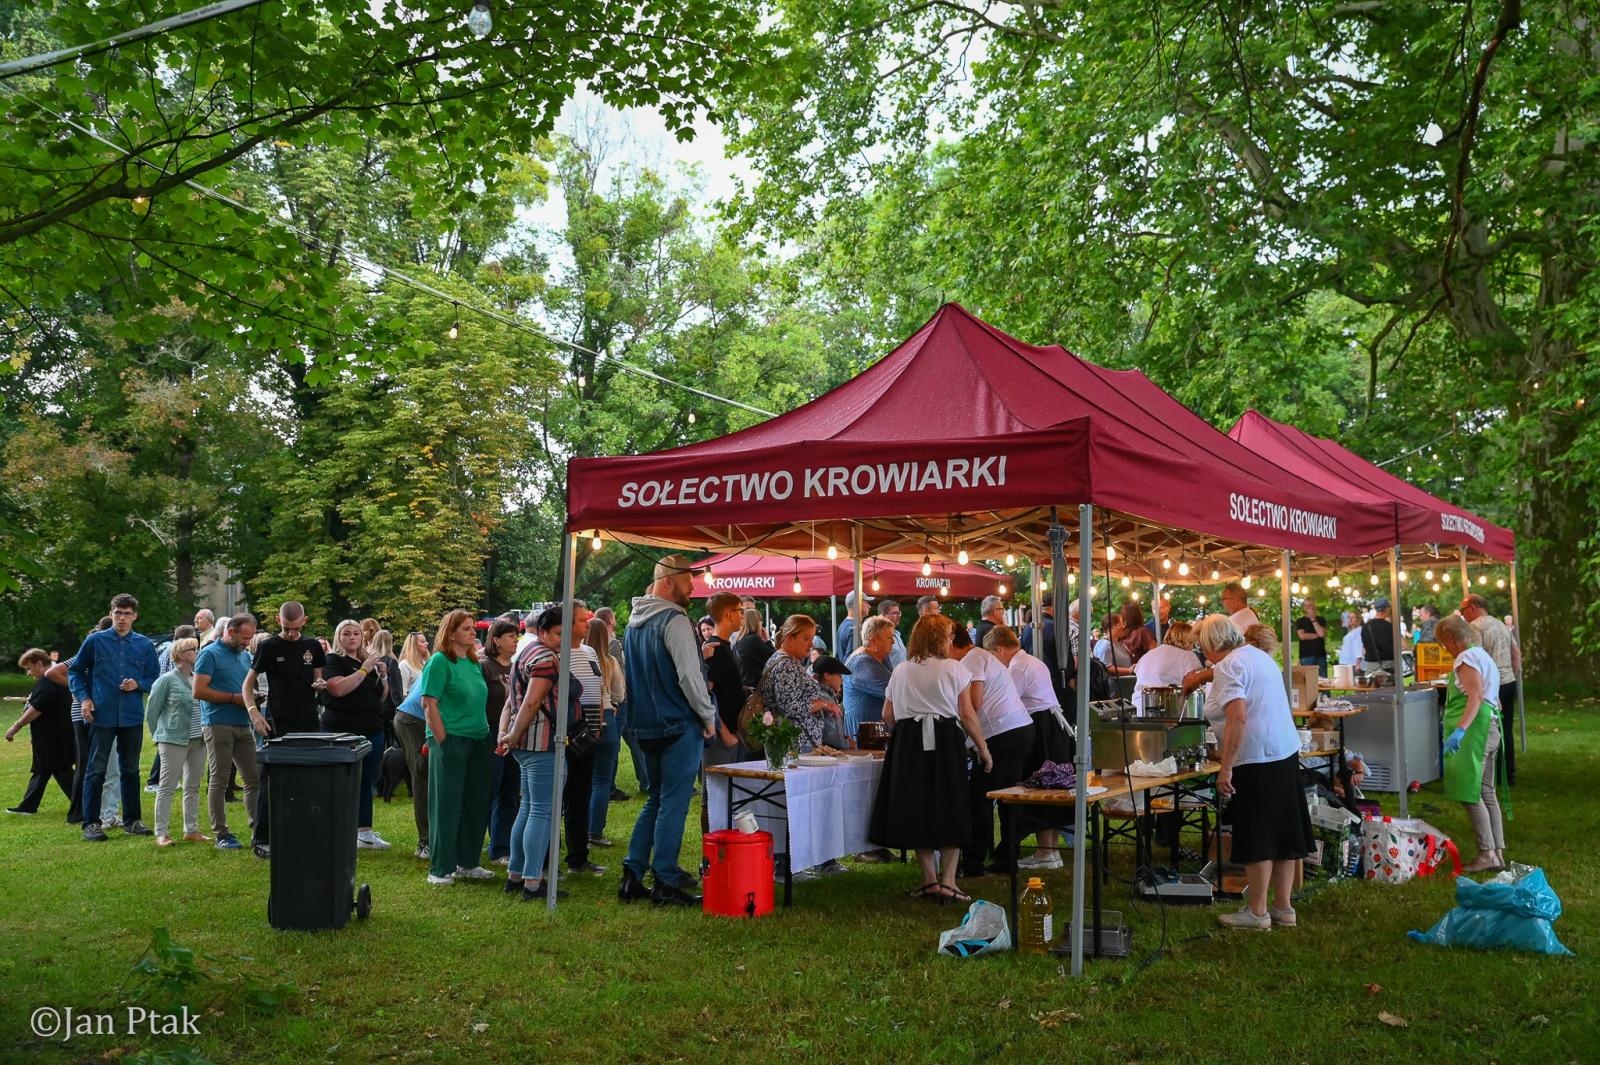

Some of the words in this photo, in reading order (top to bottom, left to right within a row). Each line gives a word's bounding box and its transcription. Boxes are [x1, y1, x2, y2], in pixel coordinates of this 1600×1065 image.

[617, 470, 794, 508] SOŁECTWO
[803, 455, 1007, 498] KROWIARKI
[1229, 492, 1288, 531] SOŁECTWO
[1289, 507, 1337, 539] KROWIARKI
[708, 576, 775, 589] KROWIARKI
